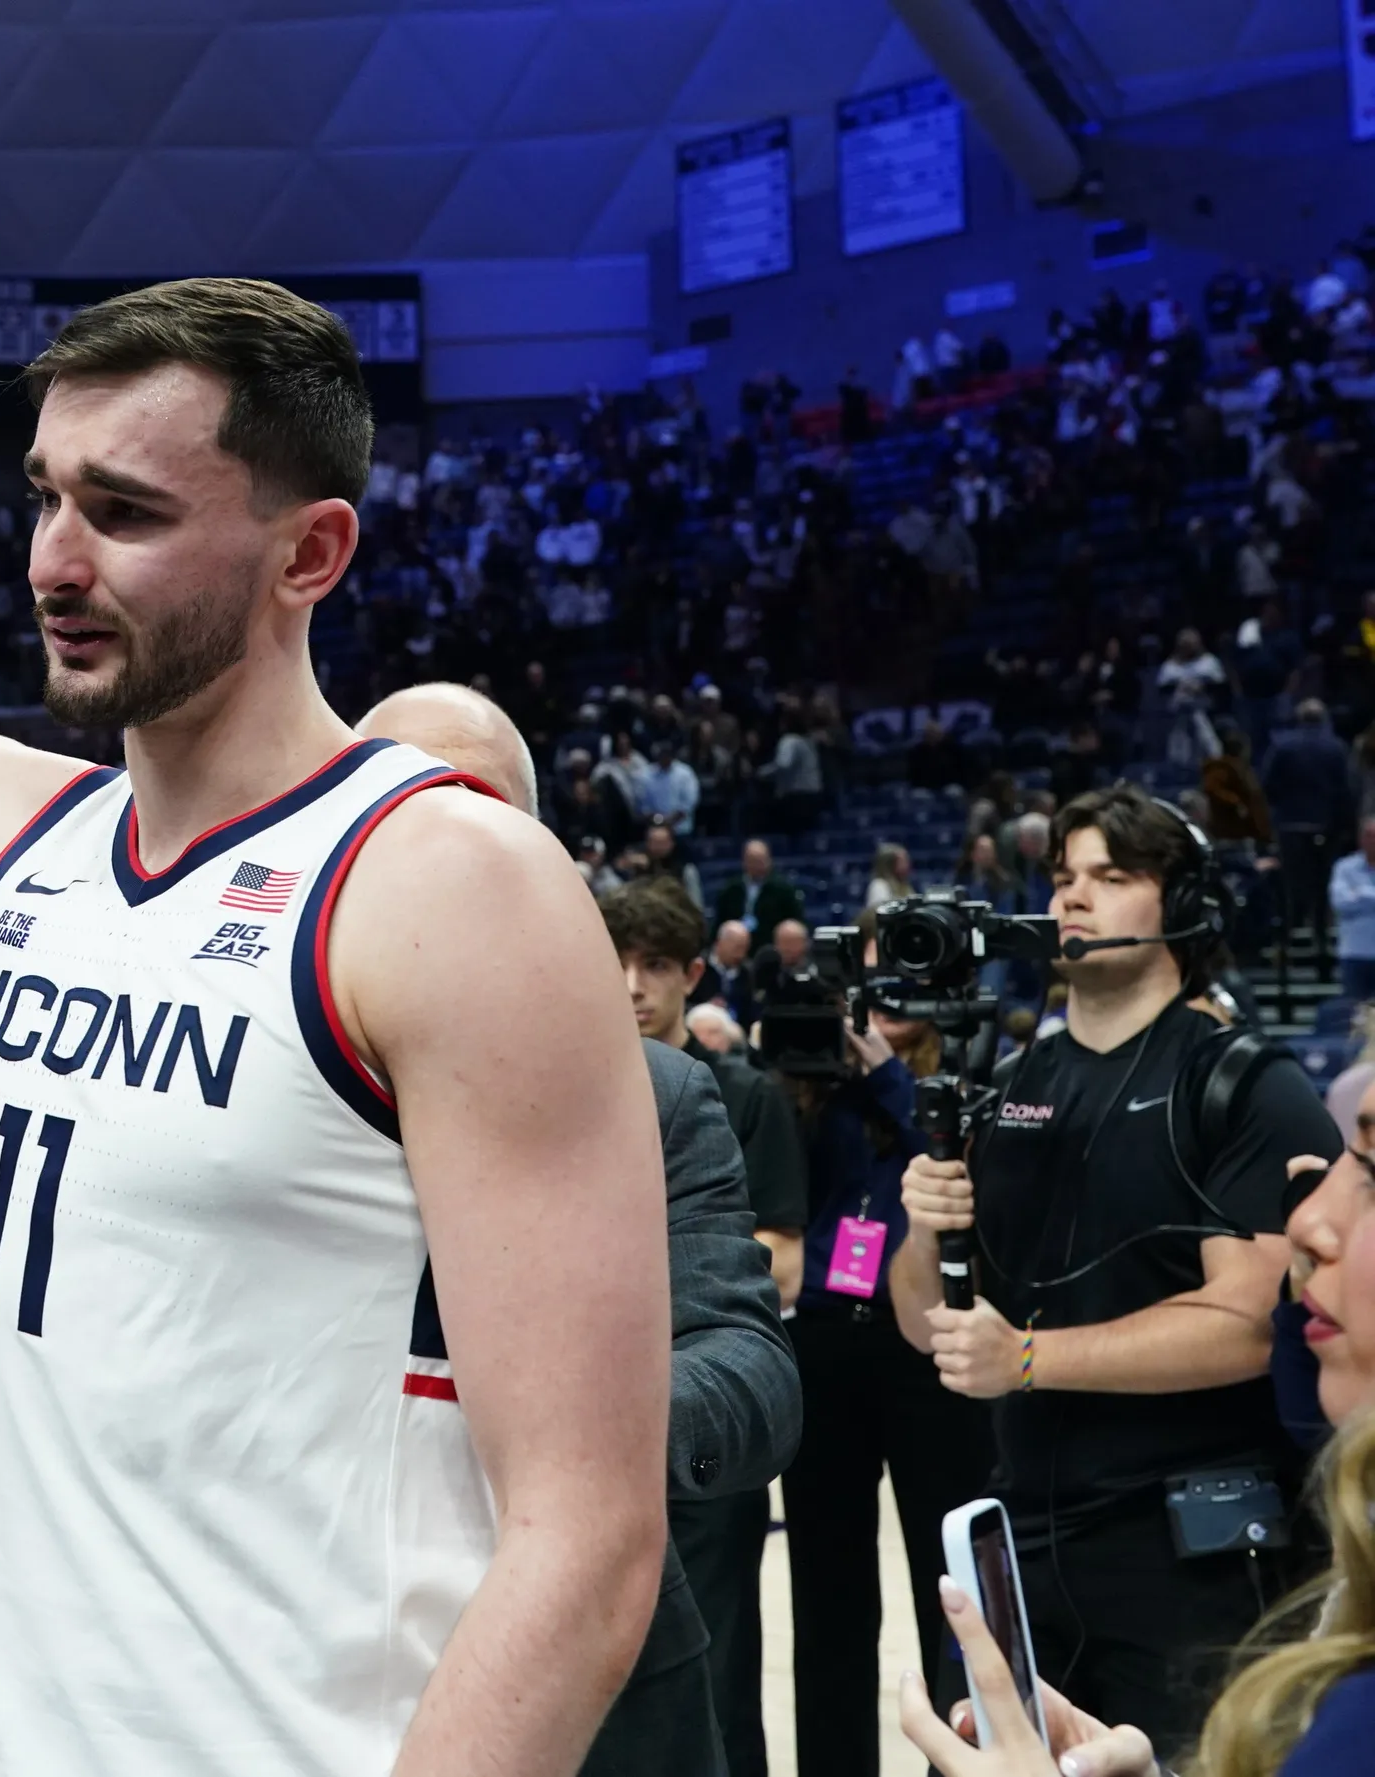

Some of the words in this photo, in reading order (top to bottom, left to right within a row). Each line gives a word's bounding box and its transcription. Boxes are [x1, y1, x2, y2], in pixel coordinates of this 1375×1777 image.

[11, 912, 37, 932] THE
[214, 922, 267, 941] BIG
[200, 938, 271, 960] EAST
[1000, 1102, 1054, 1120] CONN
